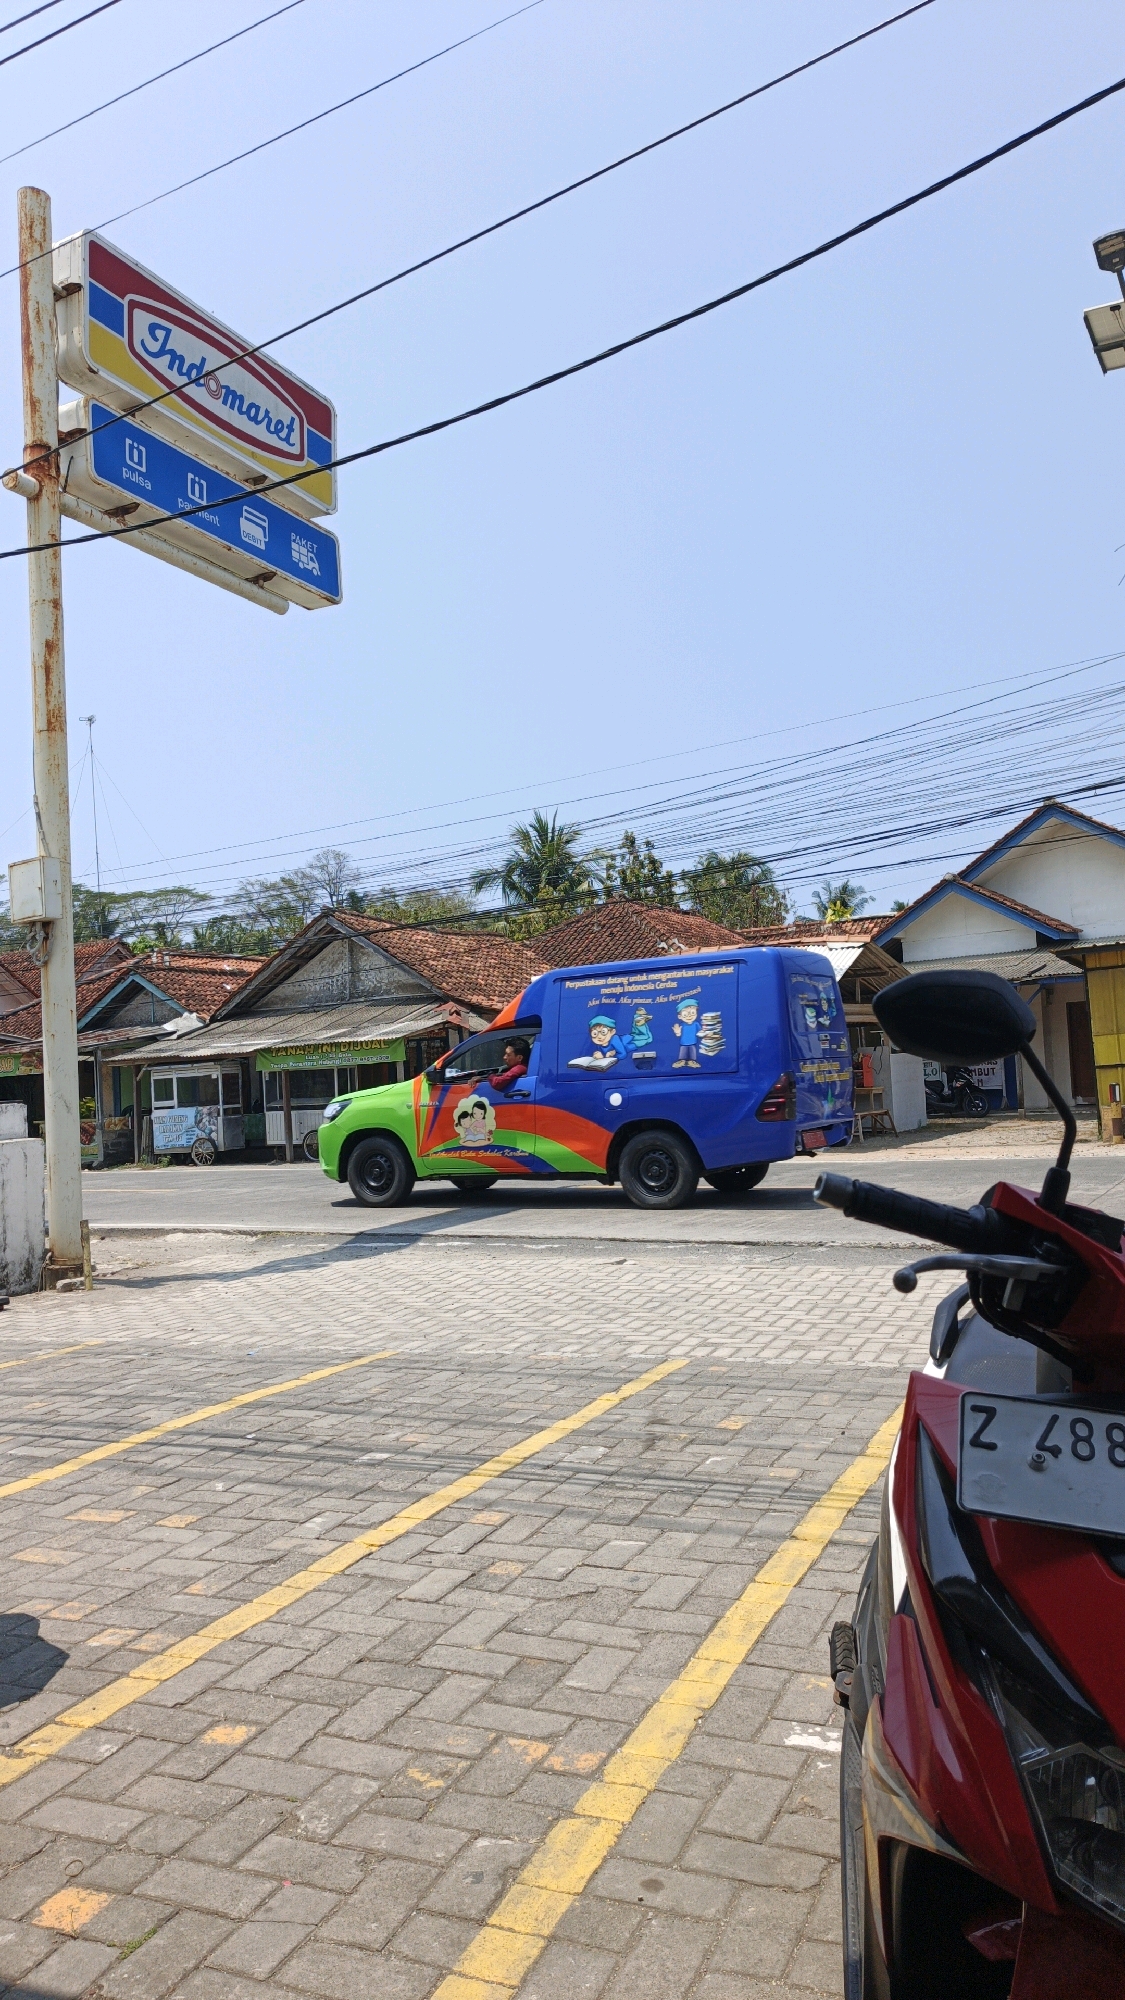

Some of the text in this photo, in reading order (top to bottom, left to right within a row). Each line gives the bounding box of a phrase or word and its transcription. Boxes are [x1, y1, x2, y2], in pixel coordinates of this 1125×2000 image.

[140, 322, 295, 447] Indomaret
[122, 466, 152, 491] pulsa
[242, 530, 263, 547] DEBIT
[291, 533, 318, 552] PAKET
[565, 966, 734, 989] Perpustakaan datang untuk mengantarkan masyarakat
[600, 981, 678, 994] menuju Indonesia Cerdas
[270, 1044, 314, 1057] TANAH
[318, 1042, 336, 1054] INI
[340, 1040, 389, 1052] DIJUAL
[969, 1404, 998, 1451] Z
